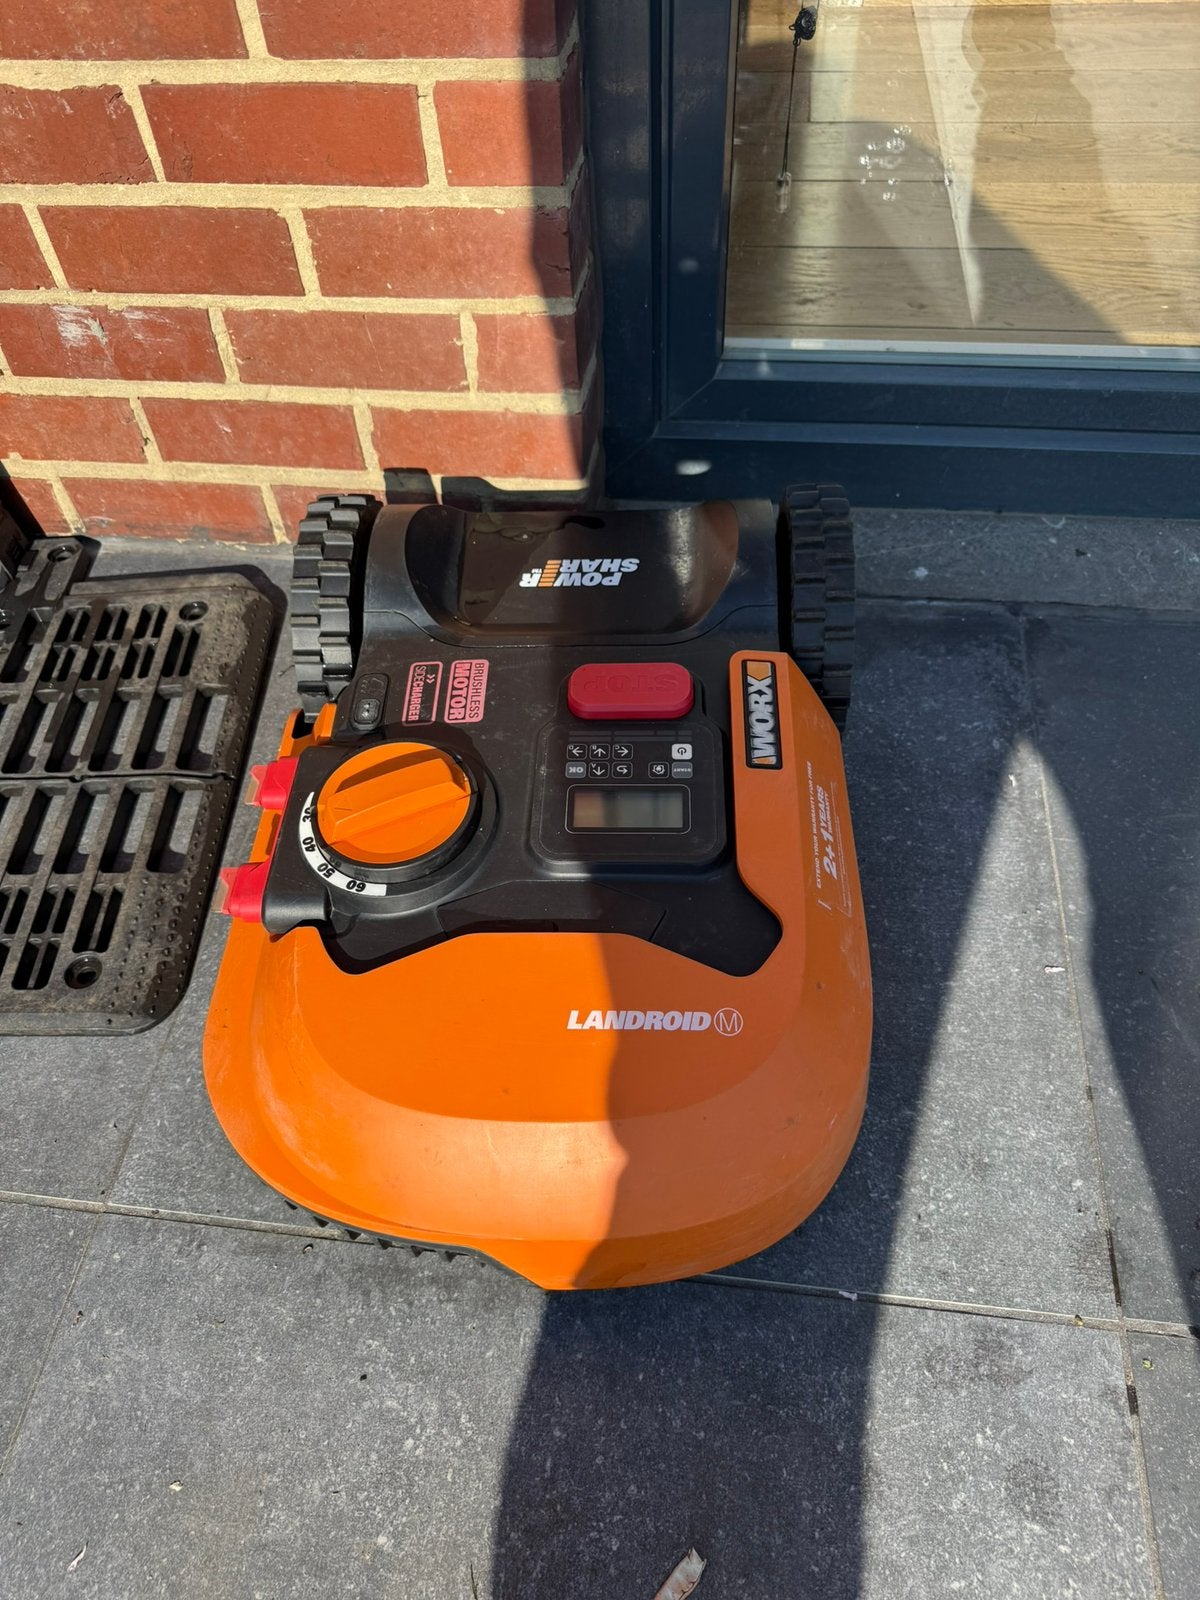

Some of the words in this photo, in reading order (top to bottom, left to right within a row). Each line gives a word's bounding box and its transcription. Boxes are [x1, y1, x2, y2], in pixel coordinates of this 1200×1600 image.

[407, 665, 427, 721] SIDECHARGER
[448, 661, 472, 720] MOTOR
[468, 662, 485, 719] BRUSHLESS
[583, 674, 680, 693] STOP
[747, 675, 776, 759] WORX
[816, 784, 828, 828] YEARS
[302, 837, 316, 852] 40
[317, 863, 336, 878] 50
[346, 880, 367, 893] 60
[566, 1009, 712, 1032] LANDROID
